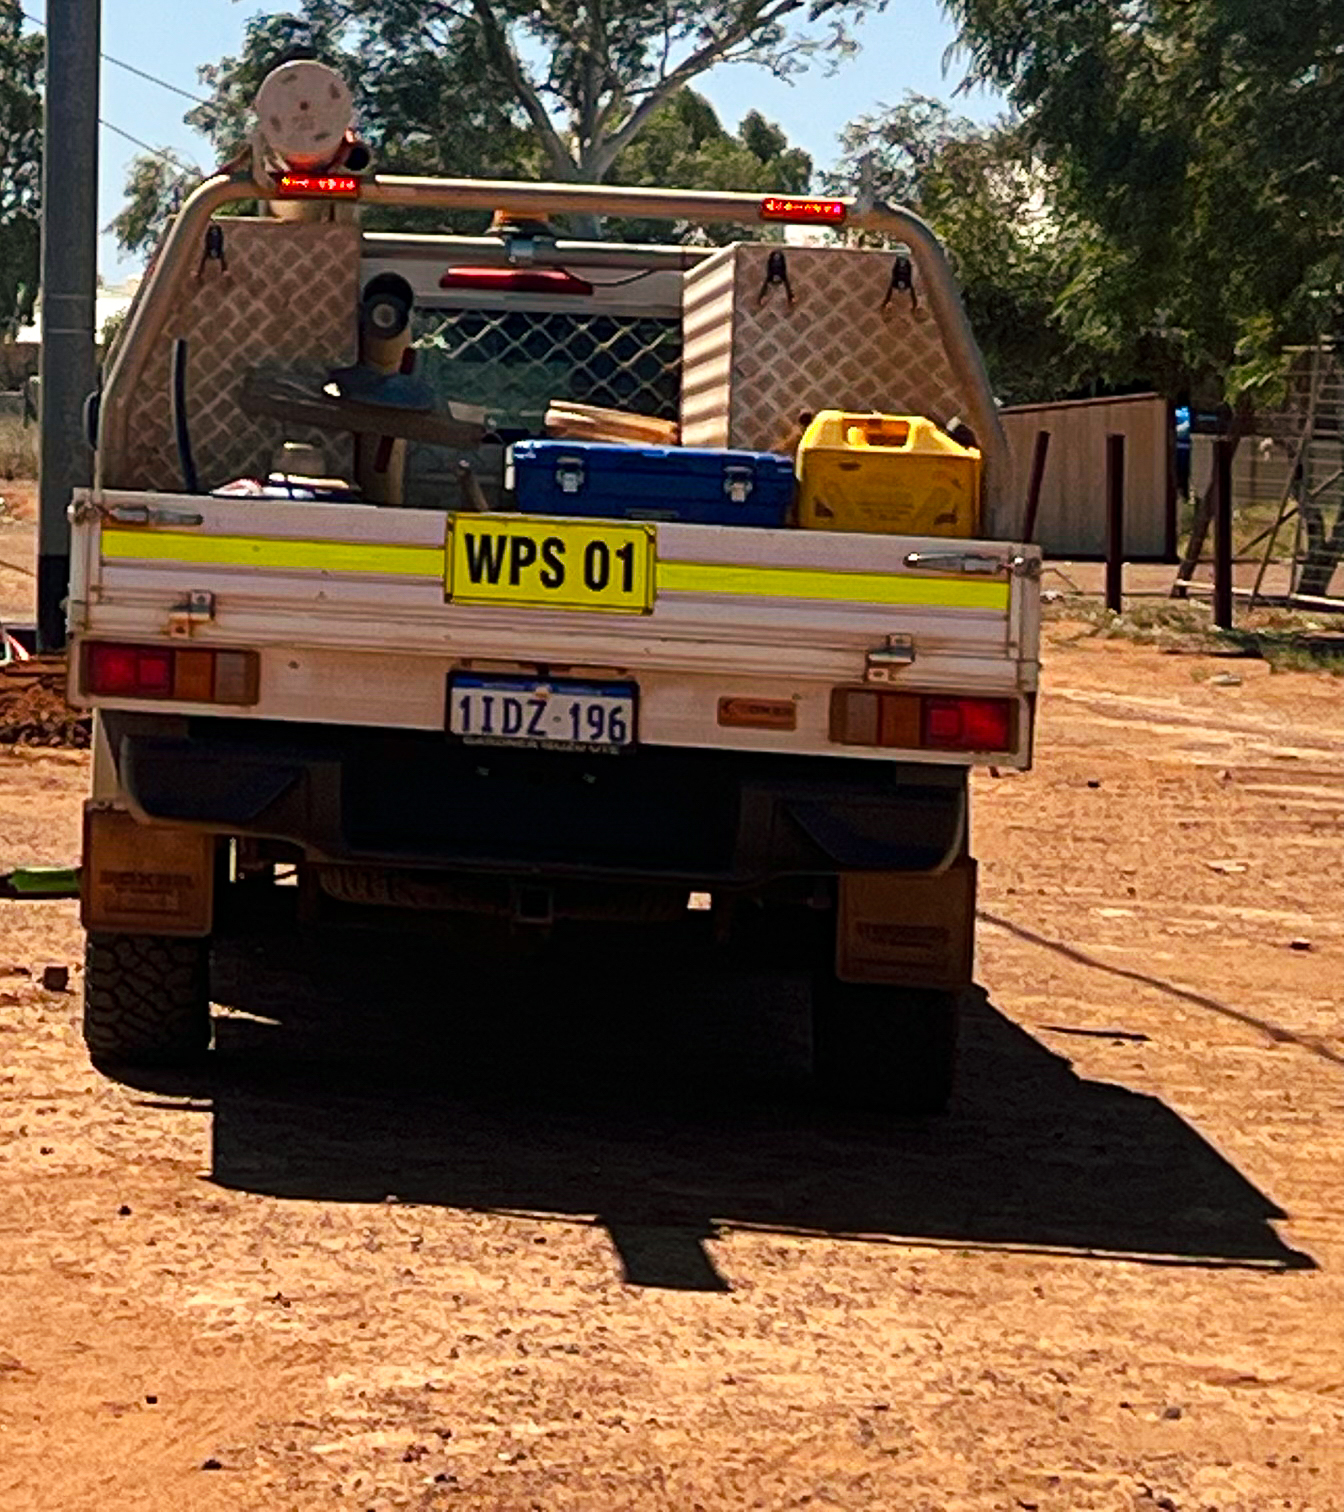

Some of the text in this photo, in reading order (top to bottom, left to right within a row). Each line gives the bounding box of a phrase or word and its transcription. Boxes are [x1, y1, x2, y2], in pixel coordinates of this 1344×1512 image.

[464, 532, 634, 592] WPS 01
[460, 695, 627, 744] 1IDZ 196
